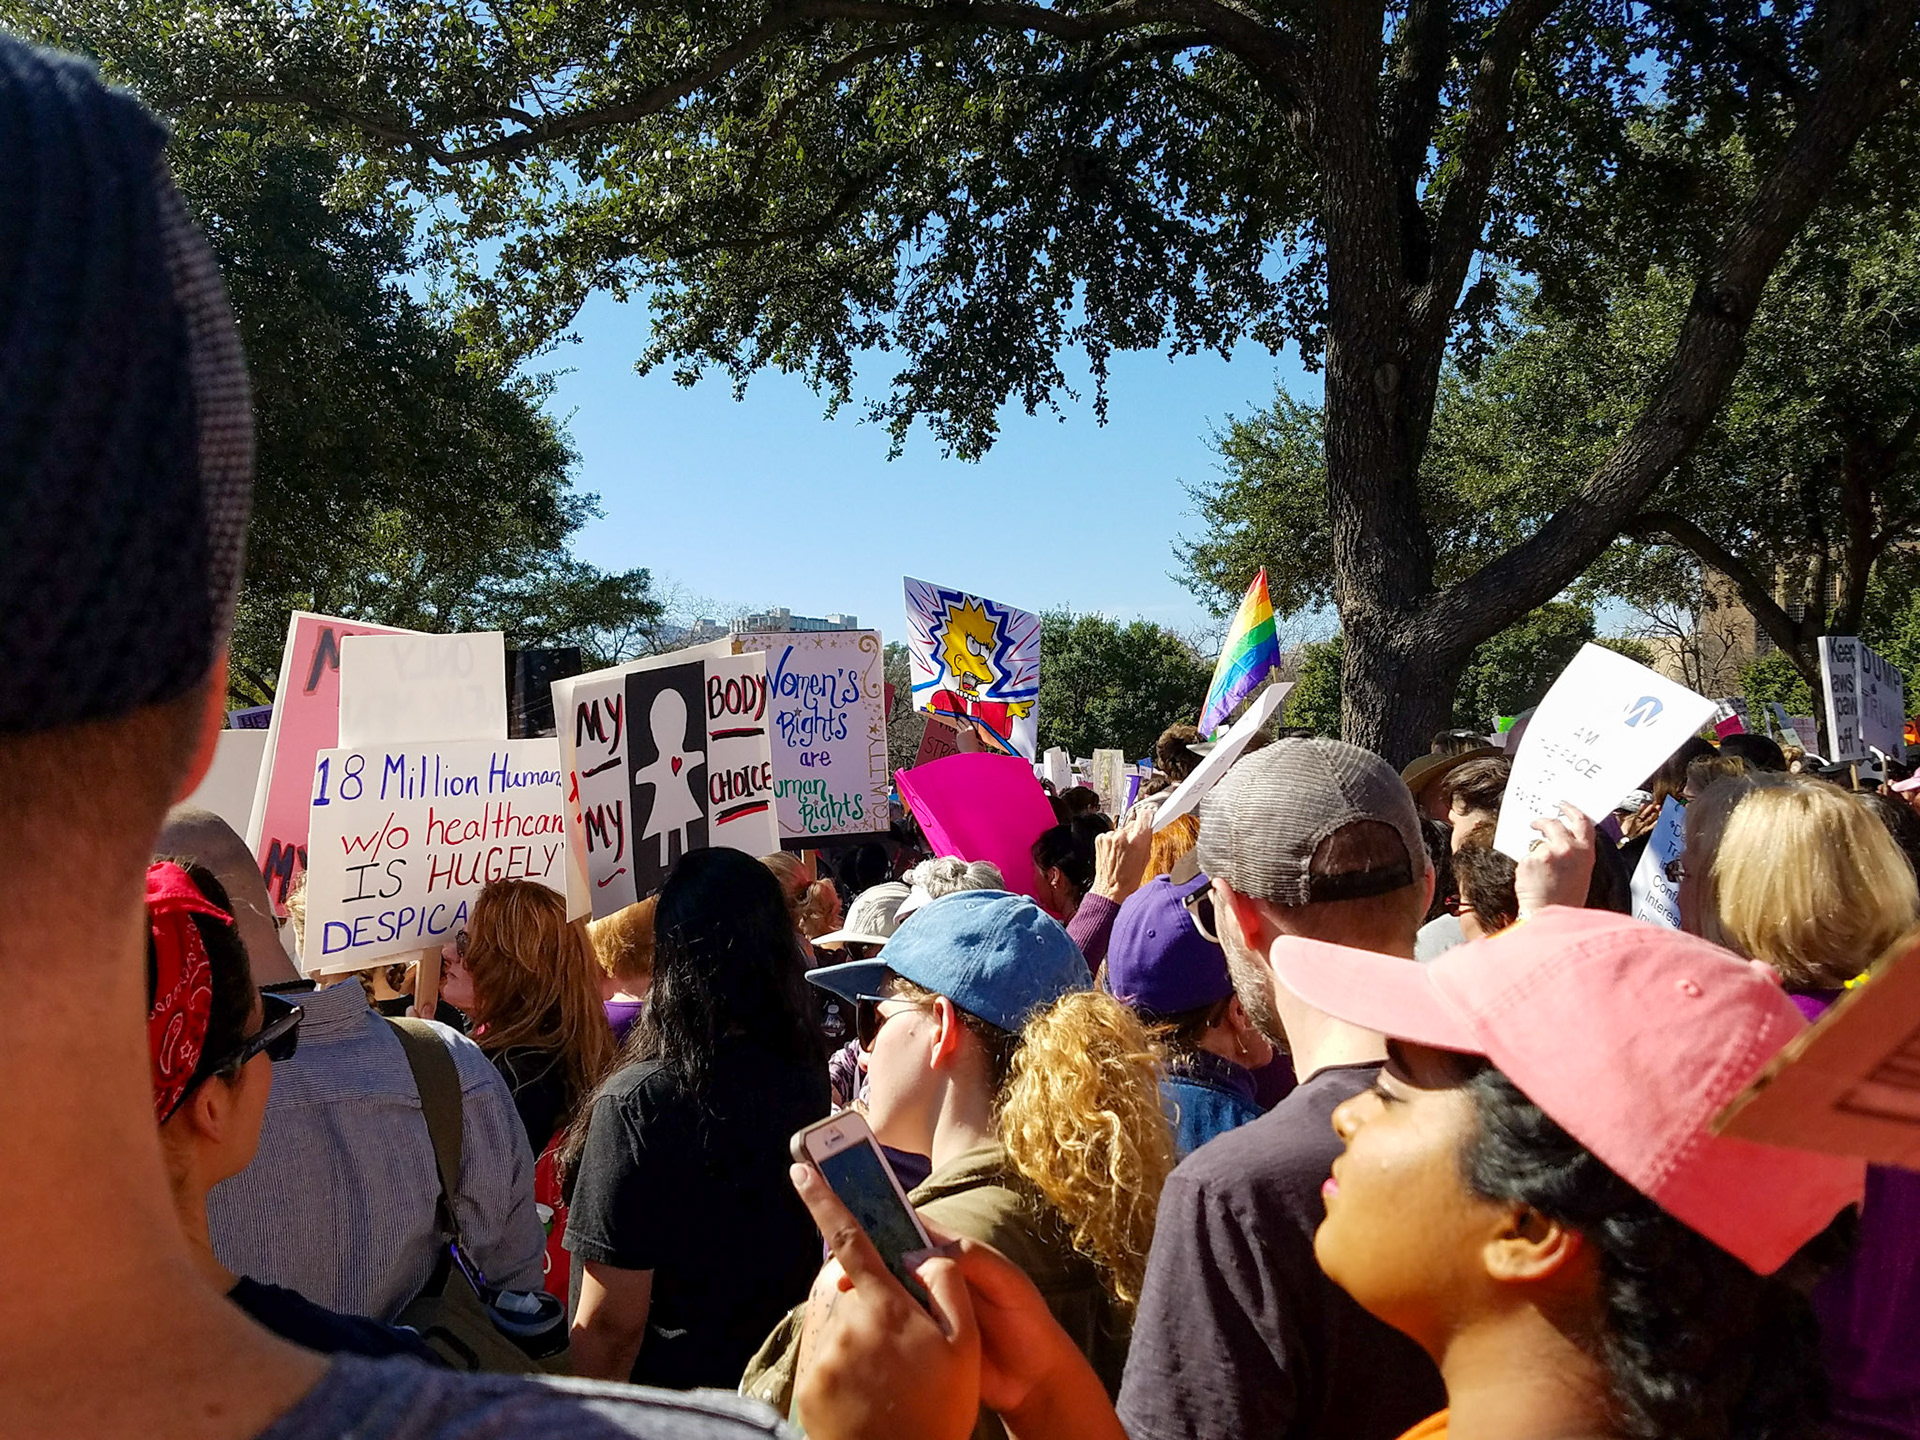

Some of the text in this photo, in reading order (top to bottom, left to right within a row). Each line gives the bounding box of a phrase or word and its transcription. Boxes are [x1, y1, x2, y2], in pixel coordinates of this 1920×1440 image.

[576, 673, 768, 756] MY BODY
[776, 706, 848, 747] Rights
[313, 752, 562, 807] 18 Million Human
[800, 750, 832, 768] are
[866, 734, 891, 832] EQUALITY
[585, 761, 773, 864] MY CHOICE
[773, 778, 827, 804] uman
[798, 792, 864, 834] Rights
[341, 812, 409, 862] w/o
[342, 858, 407, 904] IS
[322, 900, 468, 955] DESPICA
